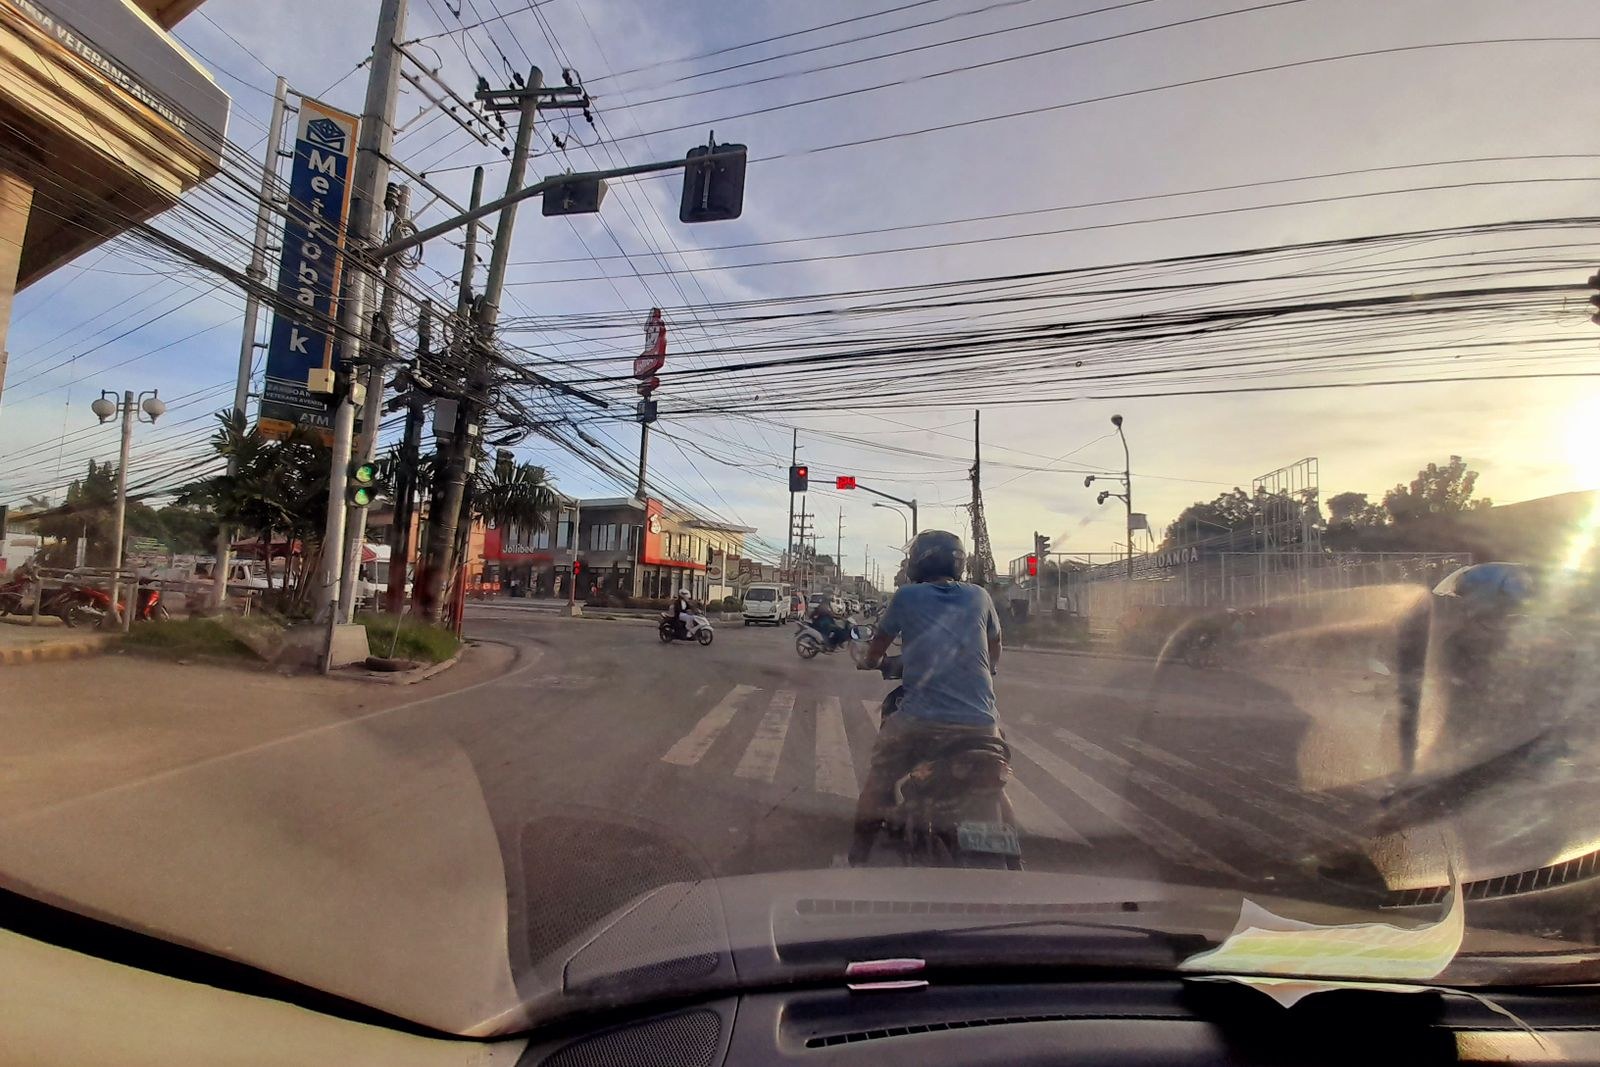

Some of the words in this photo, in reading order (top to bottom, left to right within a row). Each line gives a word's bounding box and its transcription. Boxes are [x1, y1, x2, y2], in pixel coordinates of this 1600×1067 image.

[56, 25, 131, 88] VETERANS
[130, 82, 188, 133] AVENUE
[299, 412, 329, 426] ATM
